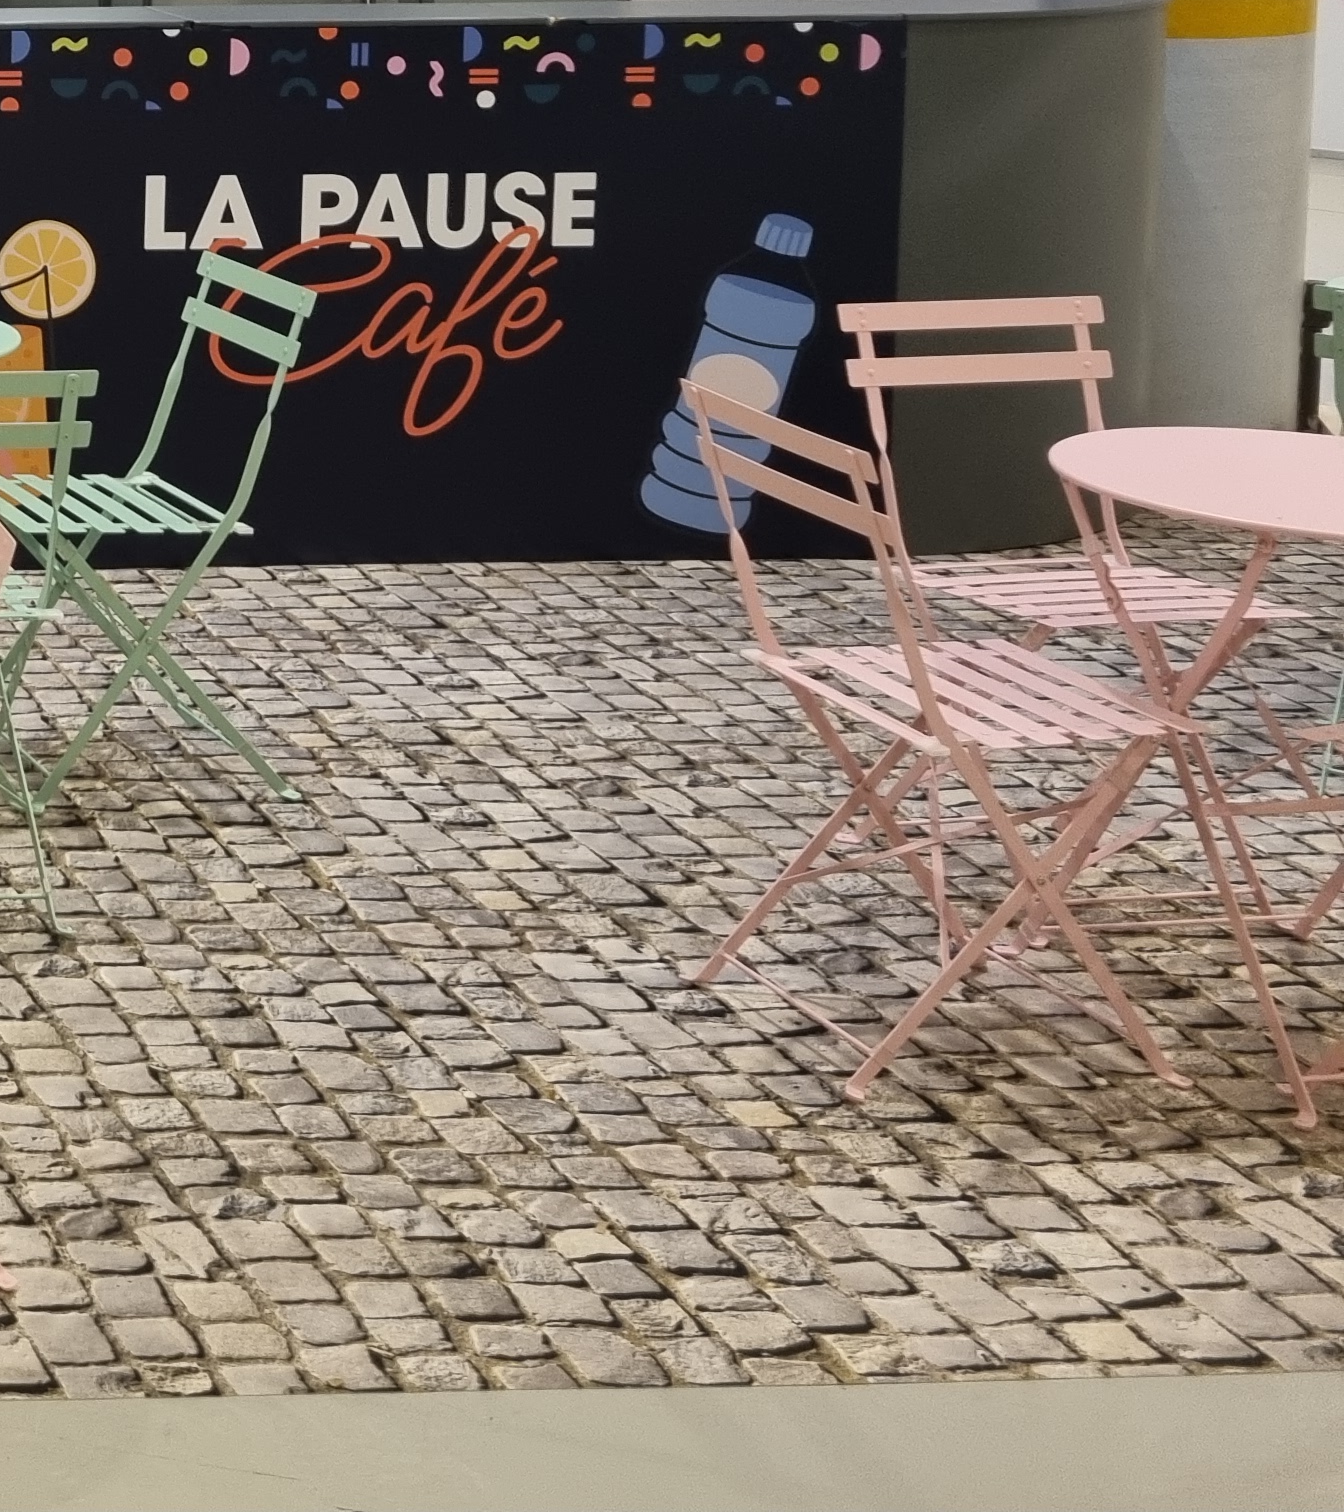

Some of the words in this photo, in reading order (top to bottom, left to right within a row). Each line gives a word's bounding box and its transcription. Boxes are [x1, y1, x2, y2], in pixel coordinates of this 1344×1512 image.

[144, 174, 263, 250] LA
[300, 171, 597, 250] PAUSE
[208, 226, 564, 437] Café
